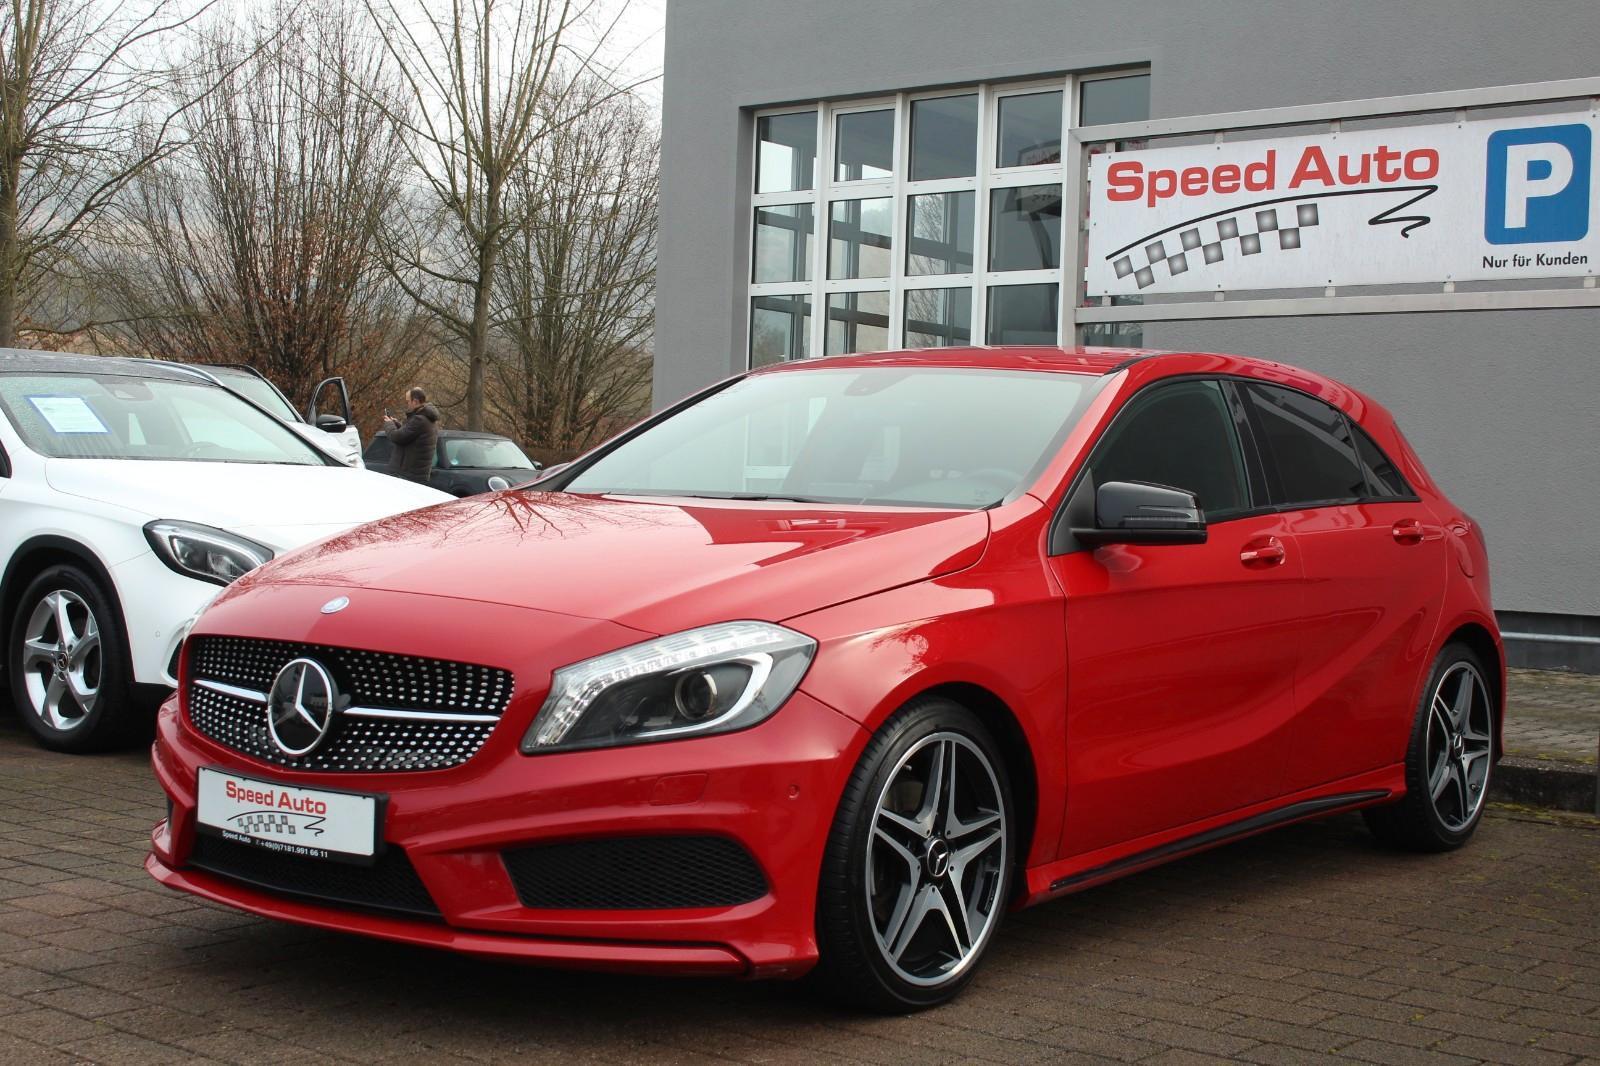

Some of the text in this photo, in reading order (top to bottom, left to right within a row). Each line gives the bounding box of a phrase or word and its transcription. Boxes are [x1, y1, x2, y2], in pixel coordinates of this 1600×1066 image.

[1106, 145, 1440, 207] Speed Auto
[1504, 142, 1574, 229] P
[1482, 251, 1588, 268] Nur für Kunden
[226, 780, 327, 815] Speed Auto
[320, 850, 328, 858] 11
